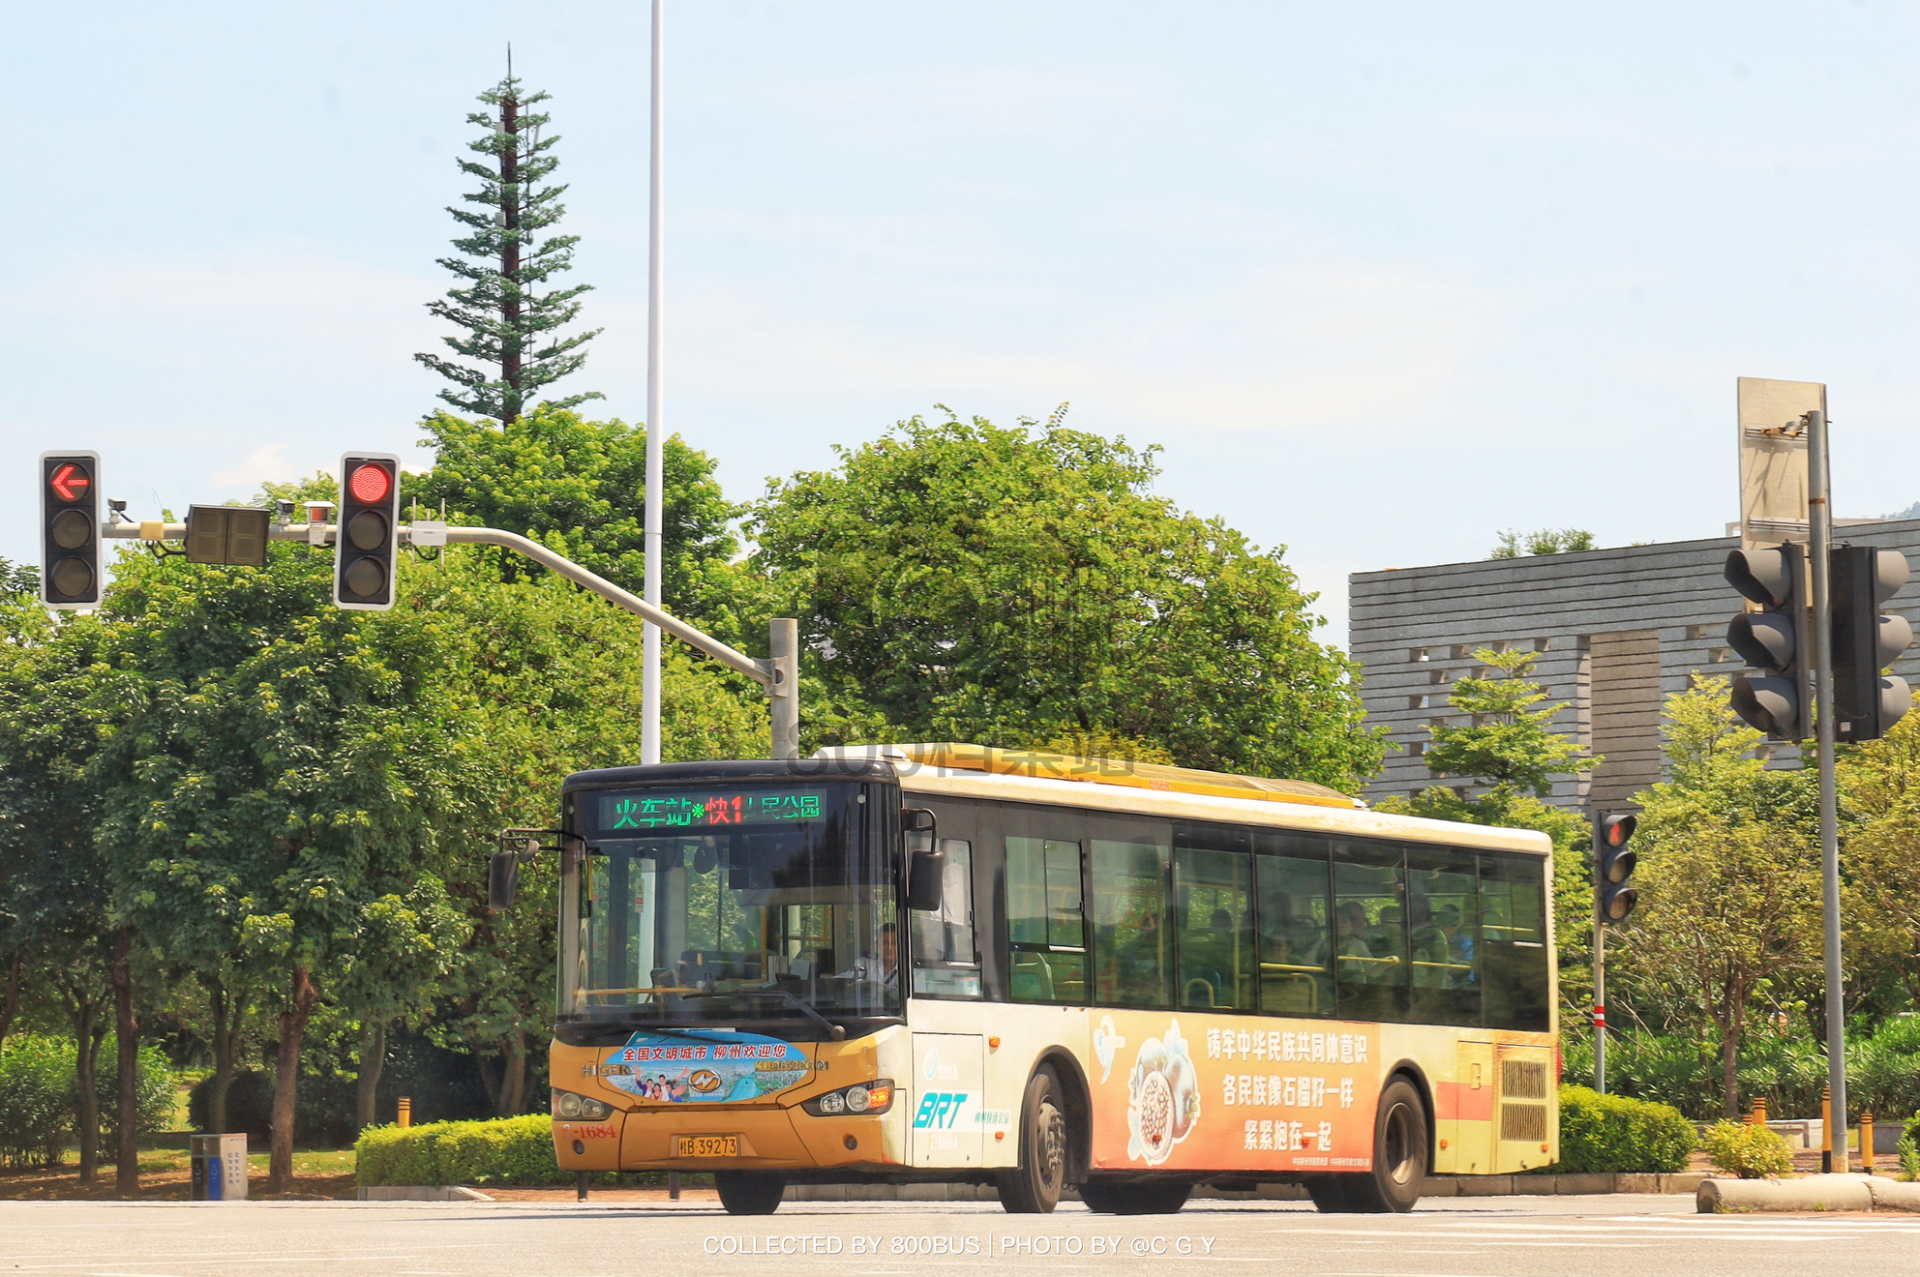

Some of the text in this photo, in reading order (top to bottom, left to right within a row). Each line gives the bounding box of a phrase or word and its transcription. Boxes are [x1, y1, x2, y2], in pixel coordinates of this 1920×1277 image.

[613, 797, 692, 829] 火车站
[705, 795, 742, 825] 快1
[622, 1043, 788, 1062] 全国文明城市 柳州欢迎您
[1206, 1027, 1369, 1065] 铸牢中华民族共同体意识
[581, 1064, 630, 1077] HIGER
[1222, 1073, 1355, 1109] 各民族像石榴籽一样
[912, 1092, 968, 1129] BRT
[1244, 1119, 1332, 1152] 紧紧抱在一起
